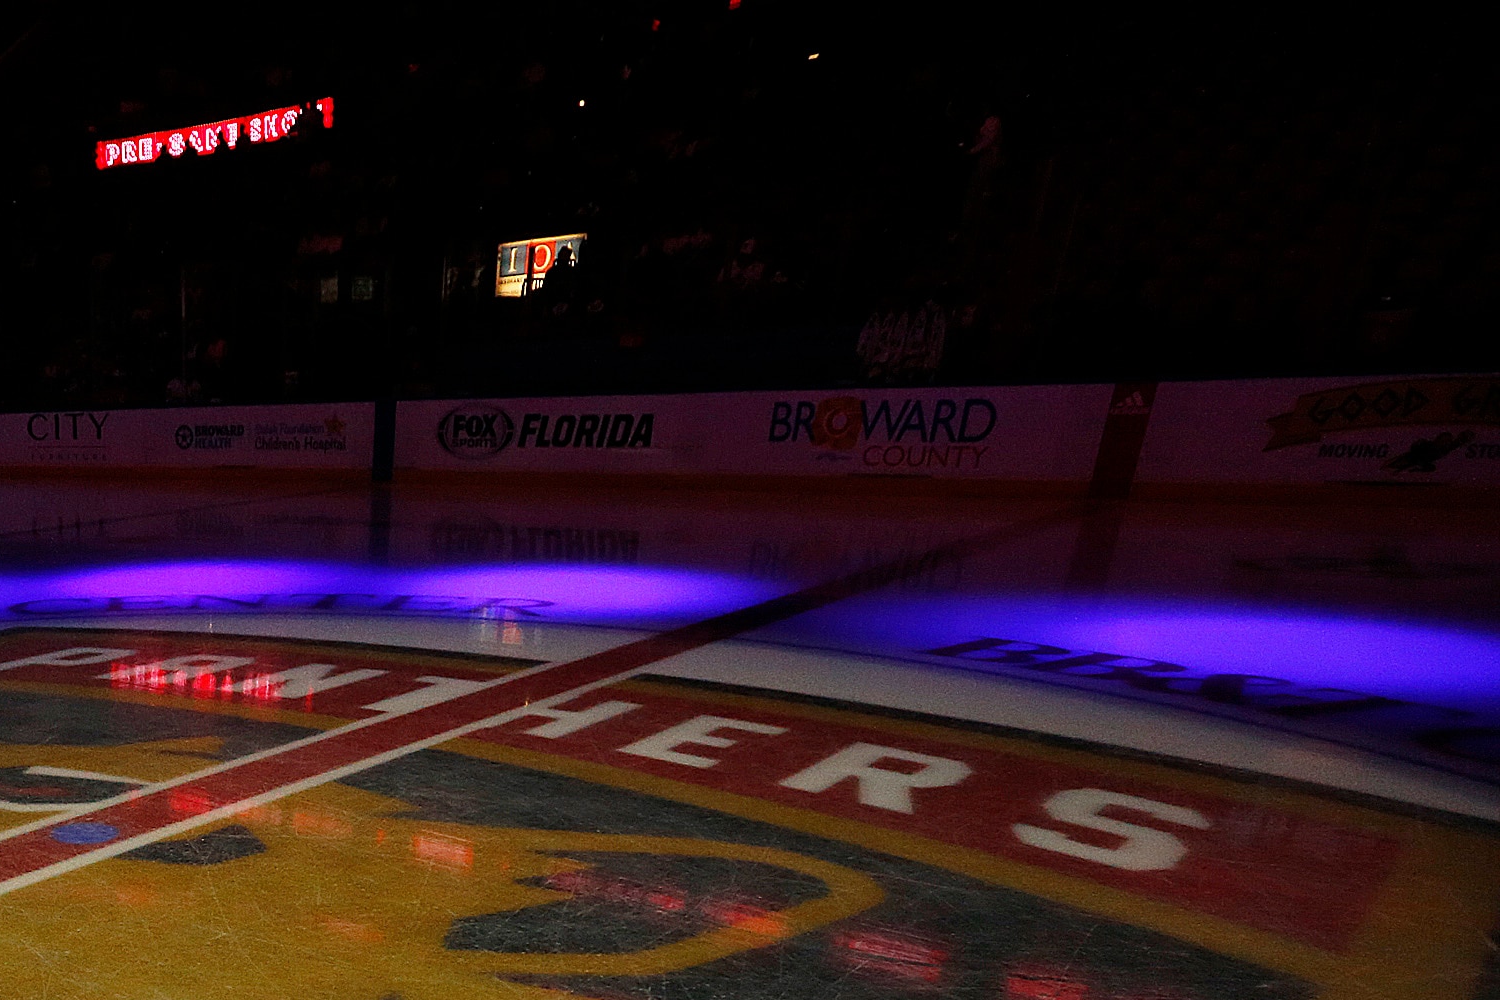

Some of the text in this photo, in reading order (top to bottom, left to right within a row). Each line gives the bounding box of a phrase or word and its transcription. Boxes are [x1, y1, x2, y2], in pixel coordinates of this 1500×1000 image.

[1309, 388, 1429, 423] GOOD
[27, 413, 109, 441] CITY
[452, 413, 655, 448] FOX FLORIDA
[768, 398, 997, 443] BROWARD
[304, 437, 347, 453] Hospital
[451, 438, 498, 449] SPORTS
[1318, 444, 1390, 458] MOVING
[863, 445, 989, 468] COUNTY
